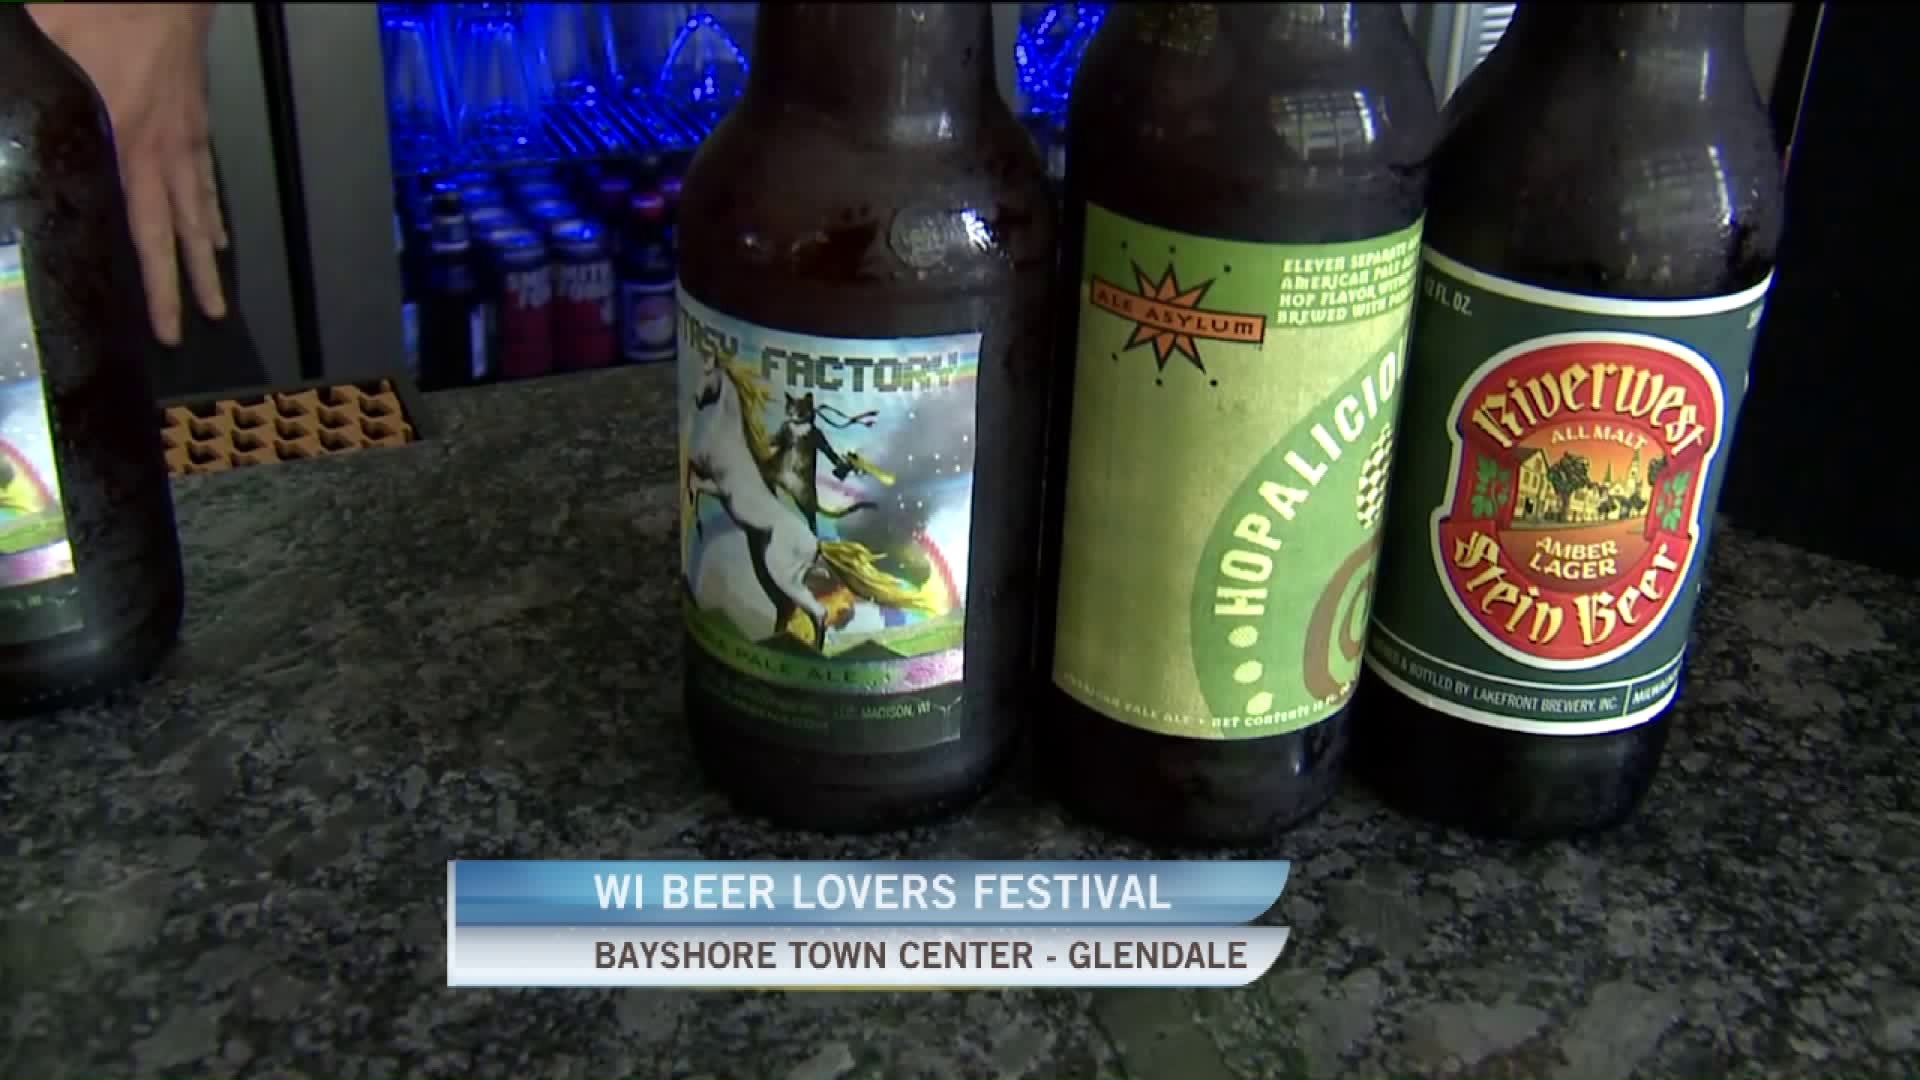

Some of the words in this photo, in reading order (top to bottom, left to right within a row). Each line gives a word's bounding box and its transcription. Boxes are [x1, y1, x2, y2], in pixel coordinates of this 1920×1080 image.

[1283, 256, 1345, 273] ELEVEN
[1281, 270, 1369, 290] AMERICAN
[1097, 288, 1133, 315] ALE
[1144, 305, 1255, 336] ASYLUM
[1277, 307, 1347, 325] BREWED
[1352, 298, 1387, 318] WITH
[1280, 294, 1315, 308] HOP
[760, 346, 959, 393] FACTORY
[1471, 362, 1707, 456] Riverwest
[1551, 425, 1591, 444] ALL
[1593, 425, 1649, 450] MALT
[1534, 535, 1620, 557] AMBER
[1529, 553, 1618, 580] LAGER
[1454, 530, 1564, 645] Stein
[1572, 542, 1679, 648] Beer
[1408, 664, 1453, 691] BOTTLED
[1454, 680, 1470, 698] BY
[1472, 684, 1540, 712] LAKEFRONT
